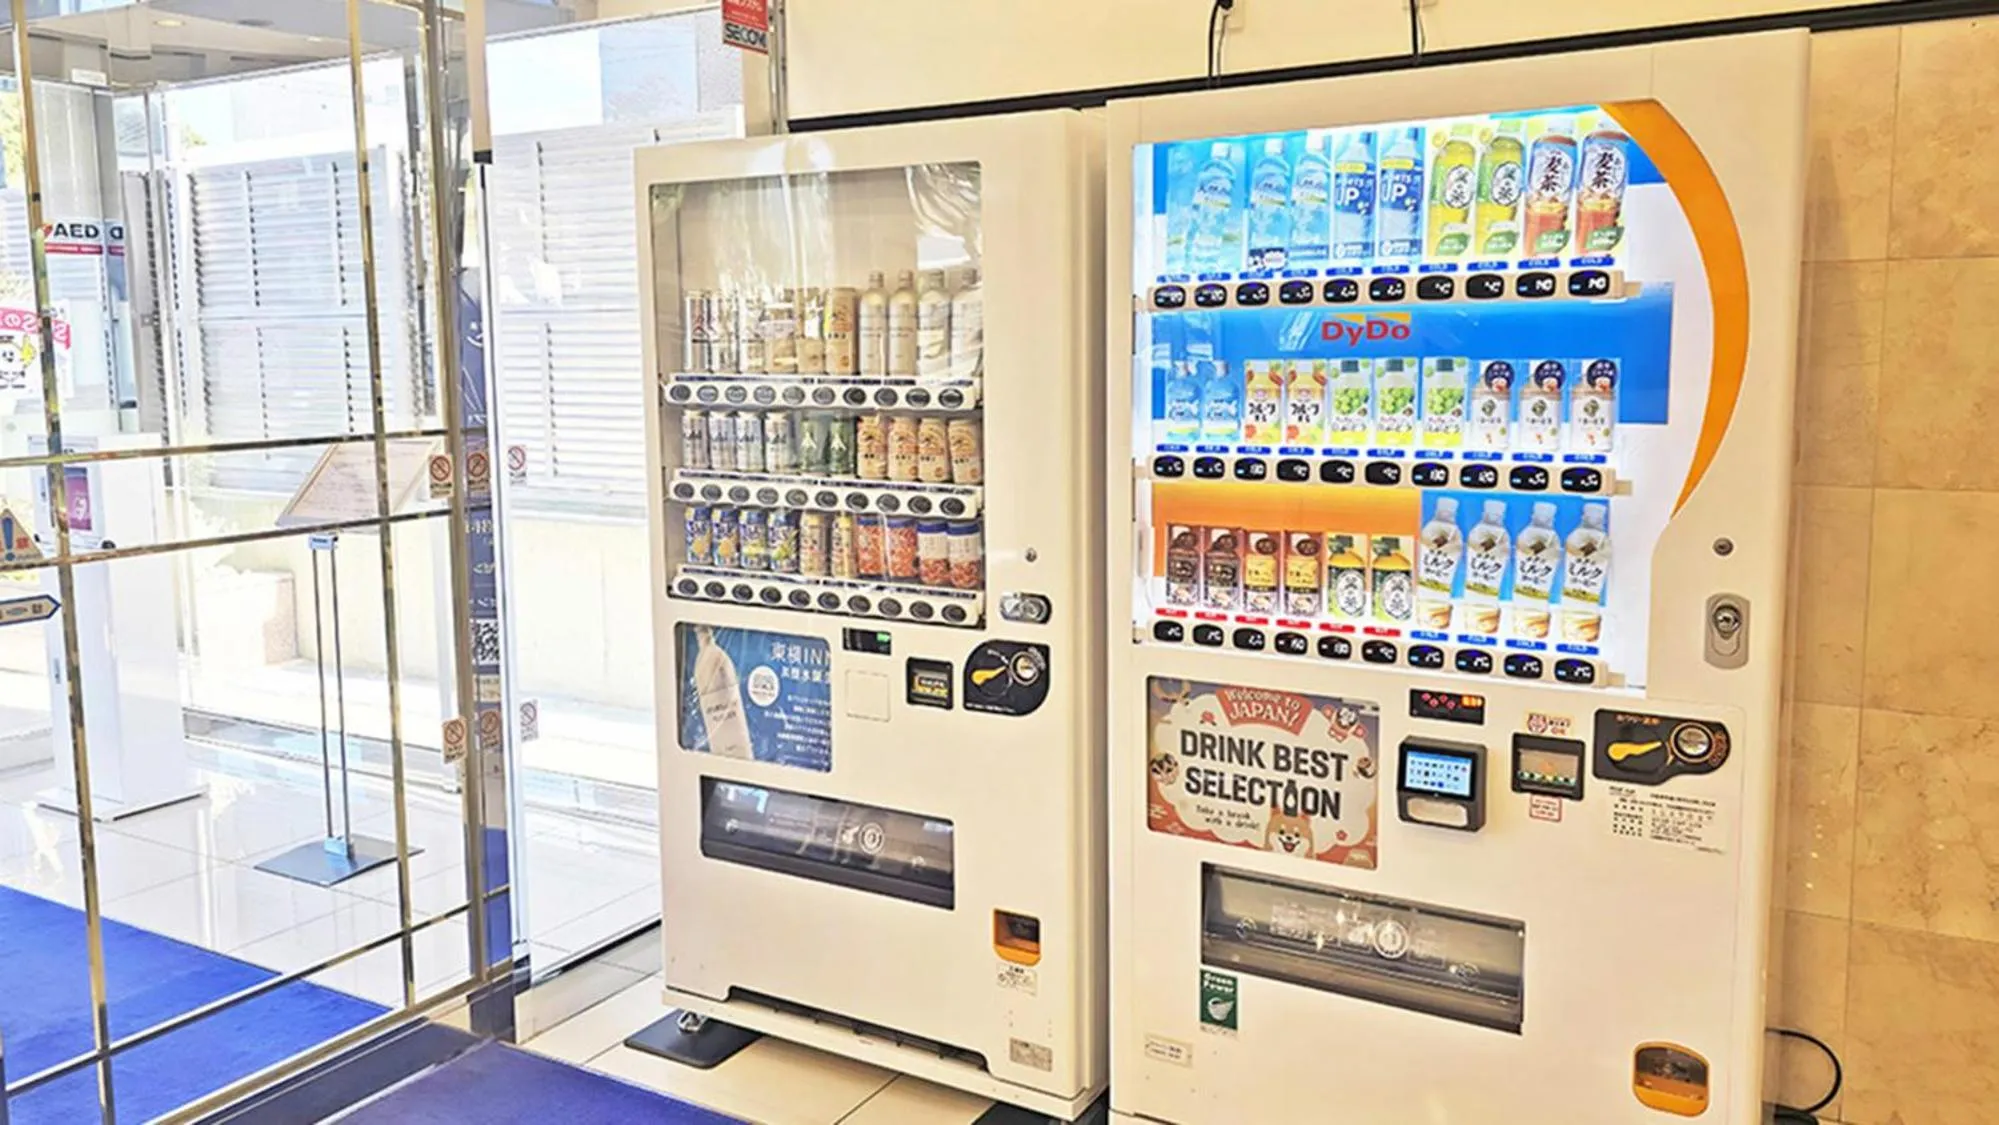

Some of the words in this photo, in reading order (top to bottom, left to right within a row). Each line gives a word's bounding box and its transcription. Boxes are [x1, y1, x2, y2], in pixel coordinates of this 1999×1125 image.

[54, 223, 99, 239] AED
[1321, 320, 1411, 347] DyDo
[1224, 688, 1281, 705] Welcome
[1285, 695, 1302, 711] to
[1229, 701, 1301, 727] JAPAN!
[1180, 728, 1265, 769] DRINK
[1273, 743, 1349, 782] BEST
[1204, 972, 1234, 986] Green
